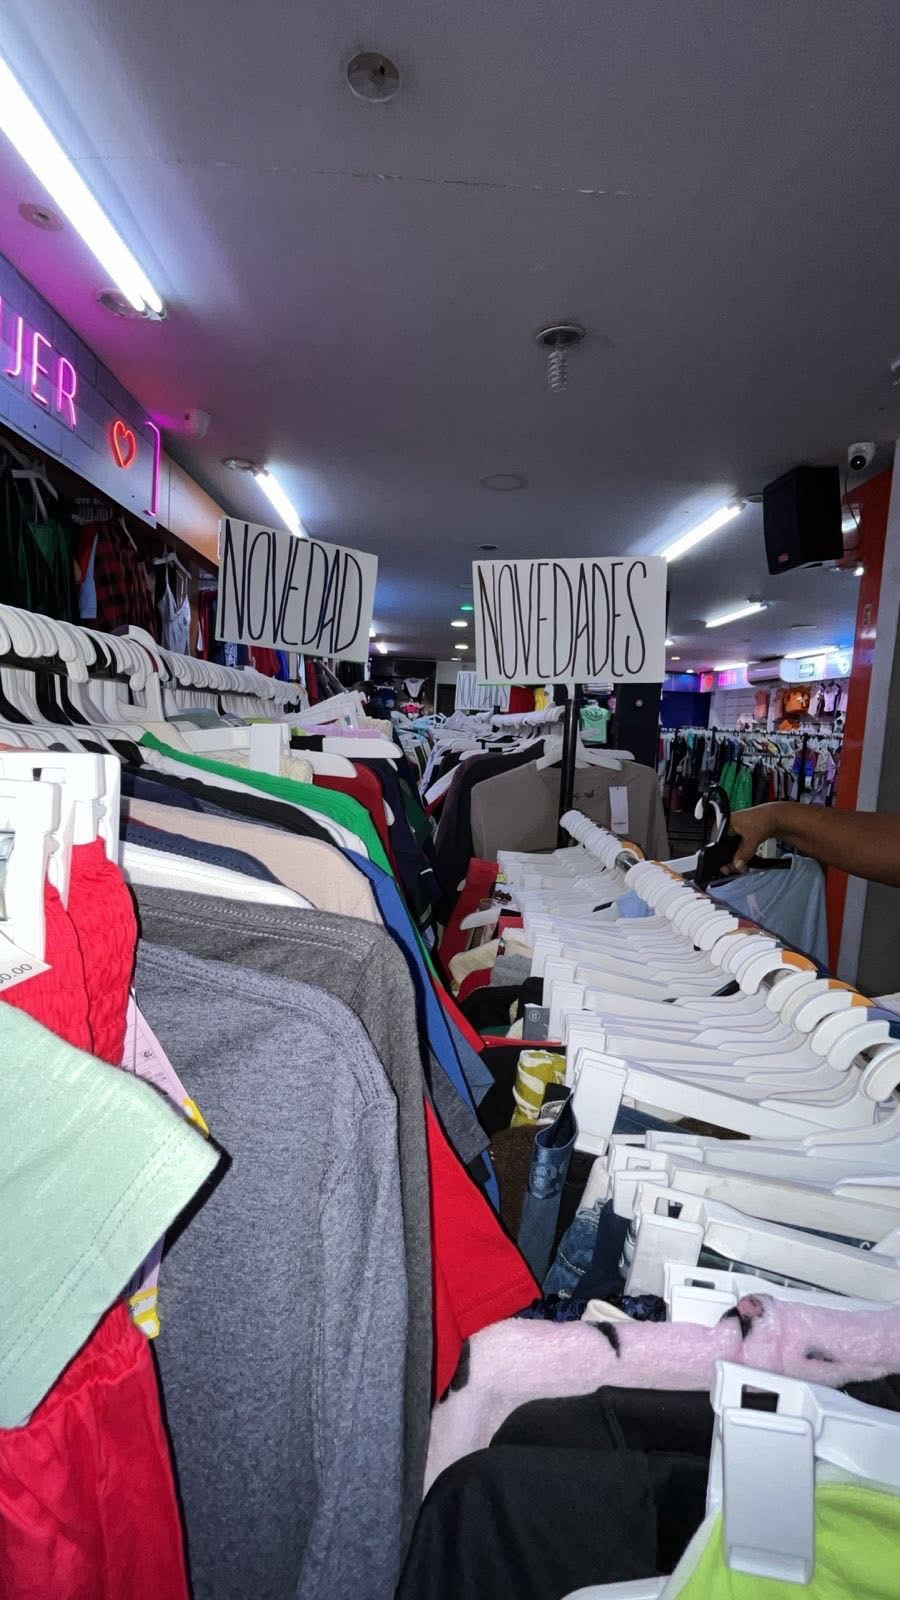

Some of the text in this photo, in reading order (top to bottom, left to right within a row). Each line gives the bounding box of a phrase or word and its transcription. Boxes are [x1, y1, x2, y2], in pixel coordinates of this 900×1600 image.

[0, 296, 77, 429] JER
[220, 518, 363, 654] NOVEDAD
[477, 560, 647, 680] NOVEDADES
[0, 963, 33, 984] 0.00
